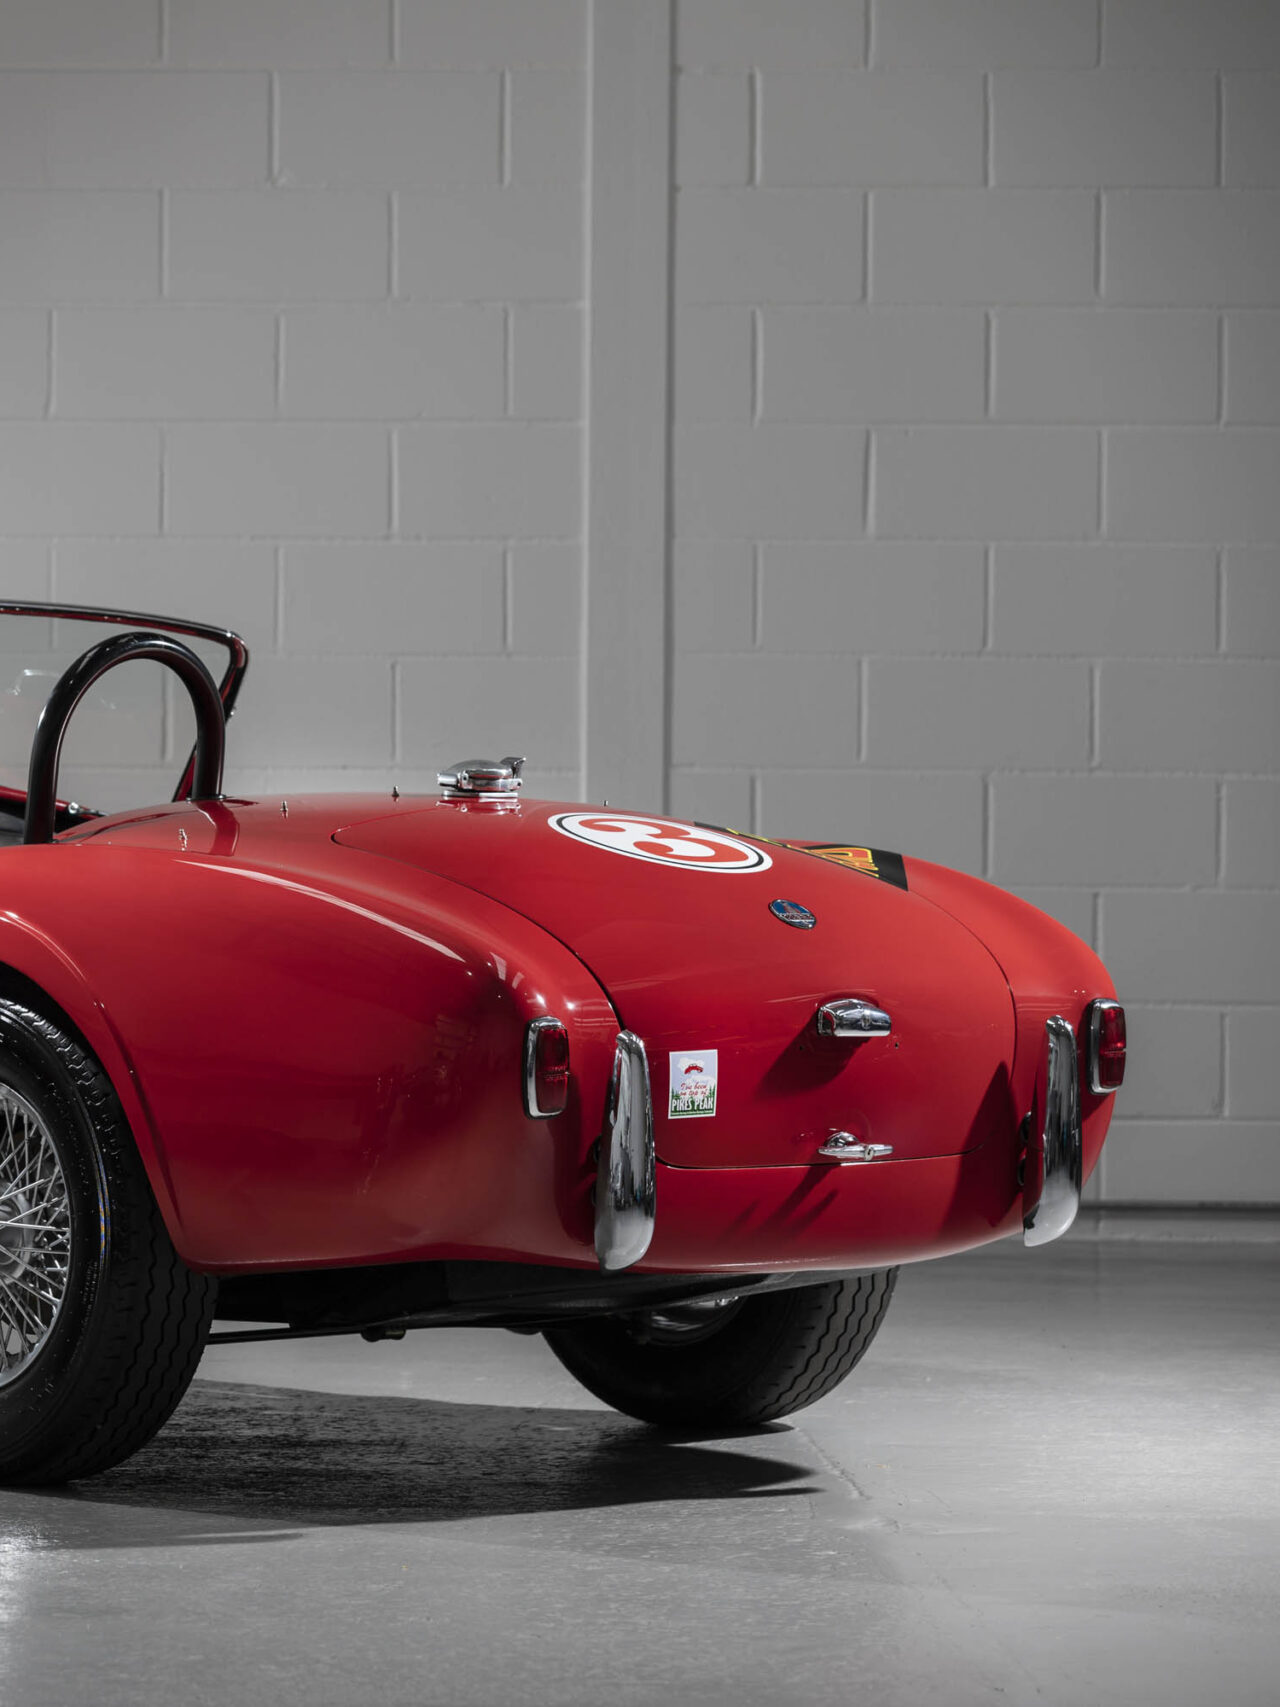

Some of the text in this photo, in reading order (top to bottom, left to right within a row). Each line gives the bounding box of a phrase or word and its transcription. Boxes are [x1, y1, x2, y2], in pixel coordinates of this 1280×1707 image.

[578, 818, 750, 864] 3
[671, 1097, 713, 1111] PIKES PEAK
